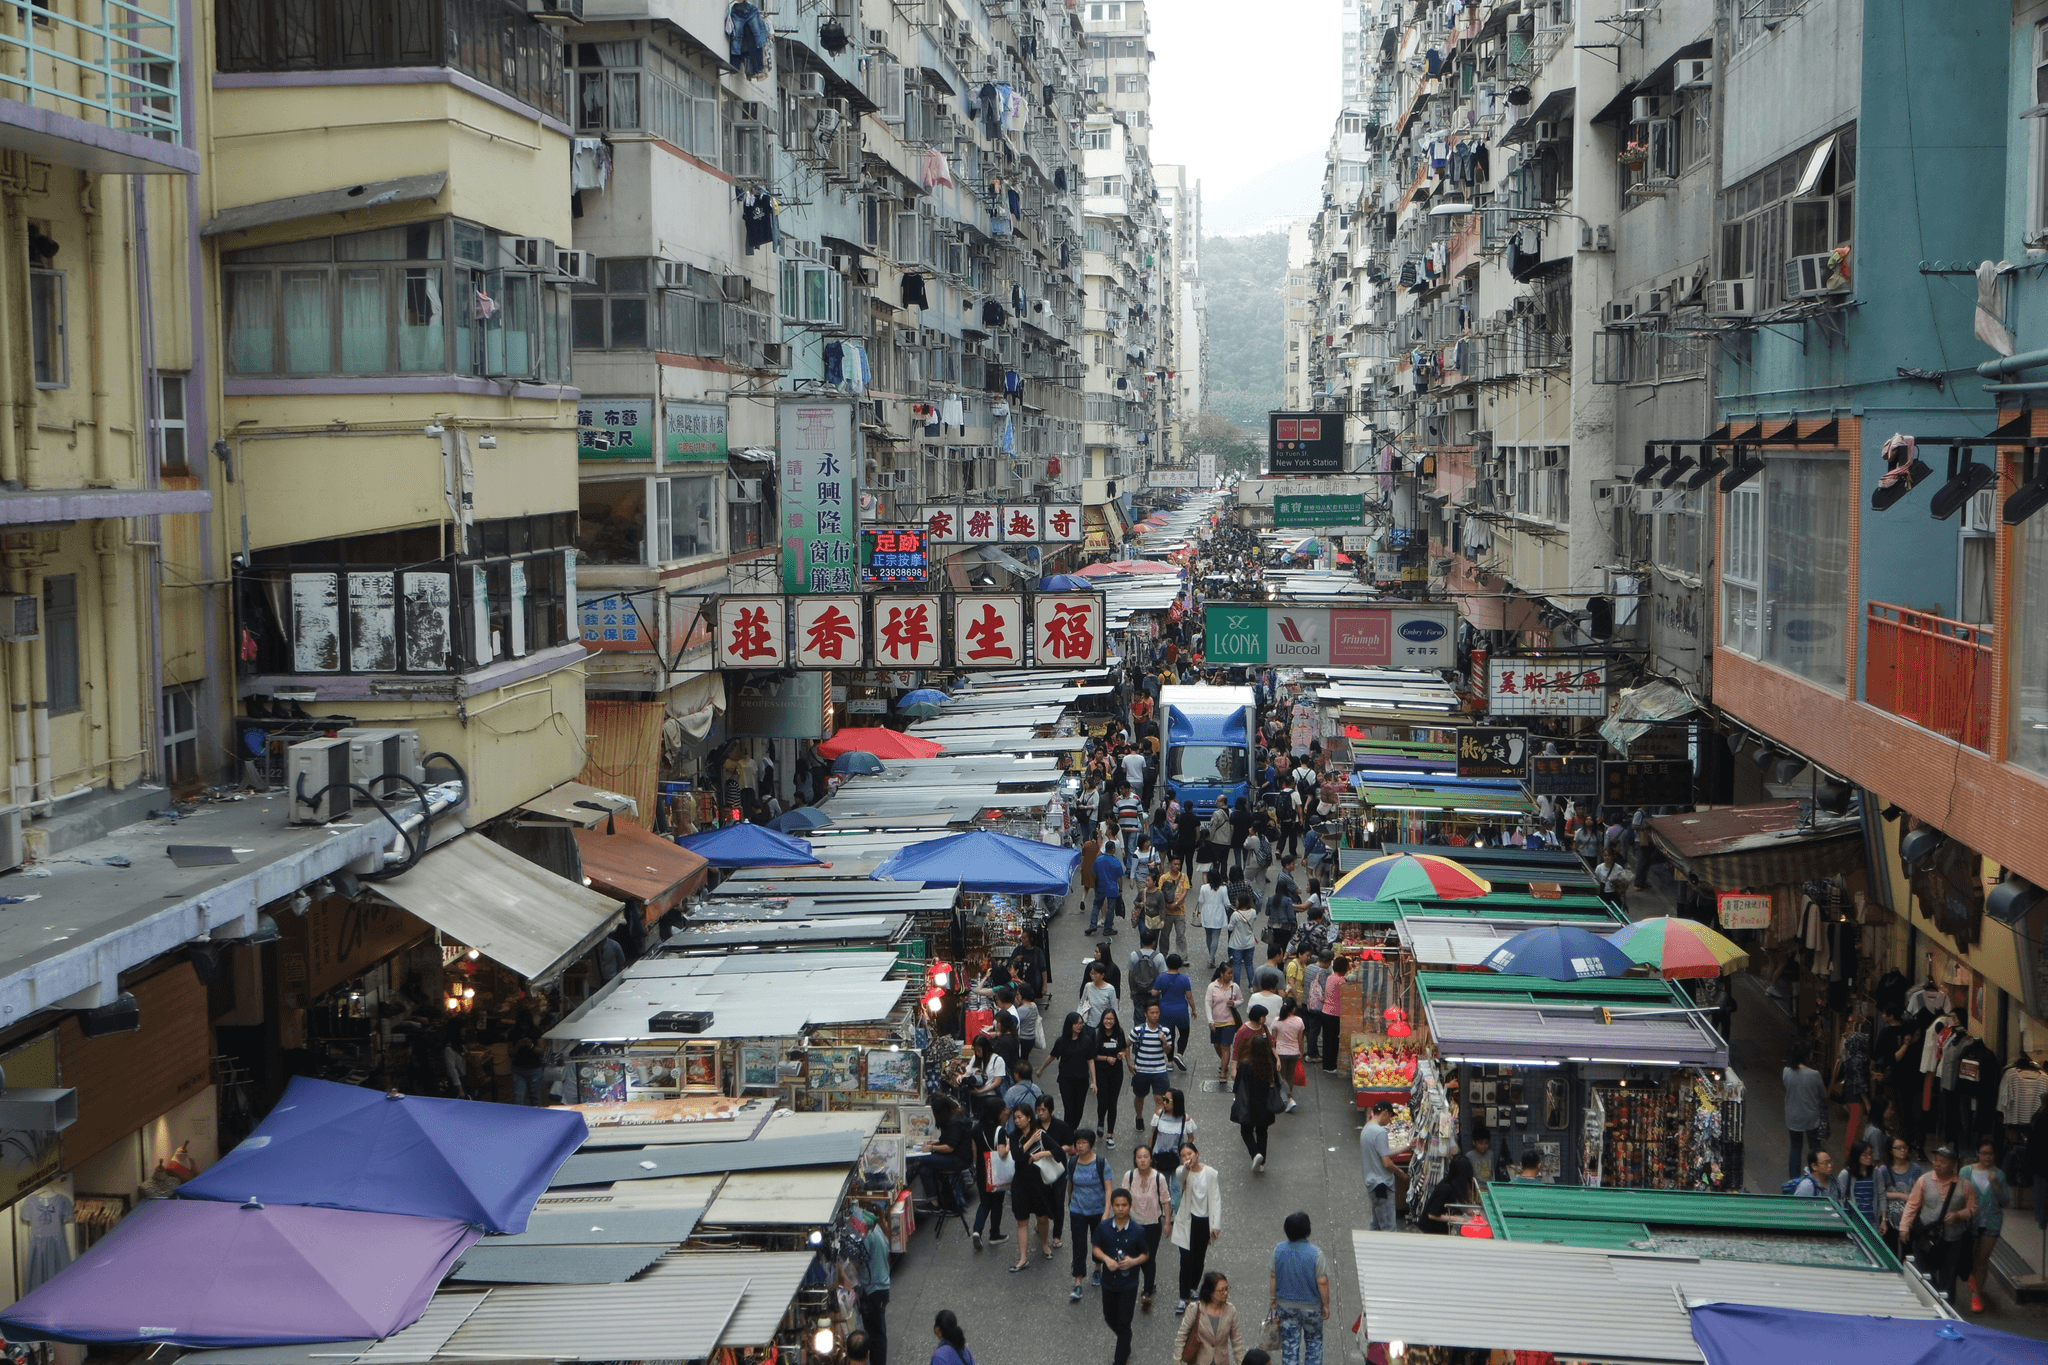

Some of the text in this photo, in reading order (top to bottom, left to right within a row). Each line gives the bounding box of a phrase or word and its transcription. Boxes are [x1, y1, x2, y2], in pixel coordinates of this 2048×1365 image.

[604, 410, 638, 426] 布藝
[578, 430, 633, 447] 業度尺
[1276, 459, 1338, 467] New York Station
[786, 460, 804, 529] 請上一樓
[817, 452, 842, 535] 永興隆
[875, 534, 920, 552] 足跡
[872, 554, 923, 567] 正宗按摩
[578, 614, 637, 626] 錢公道
[1403, 628, 1443, 638] Embry Form
[1214, 633, 1260, 655] LEONA
[1341, 633, 1380, 648] Triumph
[1275, 643, 1321, 655] Wacoal
[1406, 647, 1439, 656] 安莉芳
[741, 700, 808, 708] PROFESSIONAL
[1468, 767, 1501, 775] 34810700
